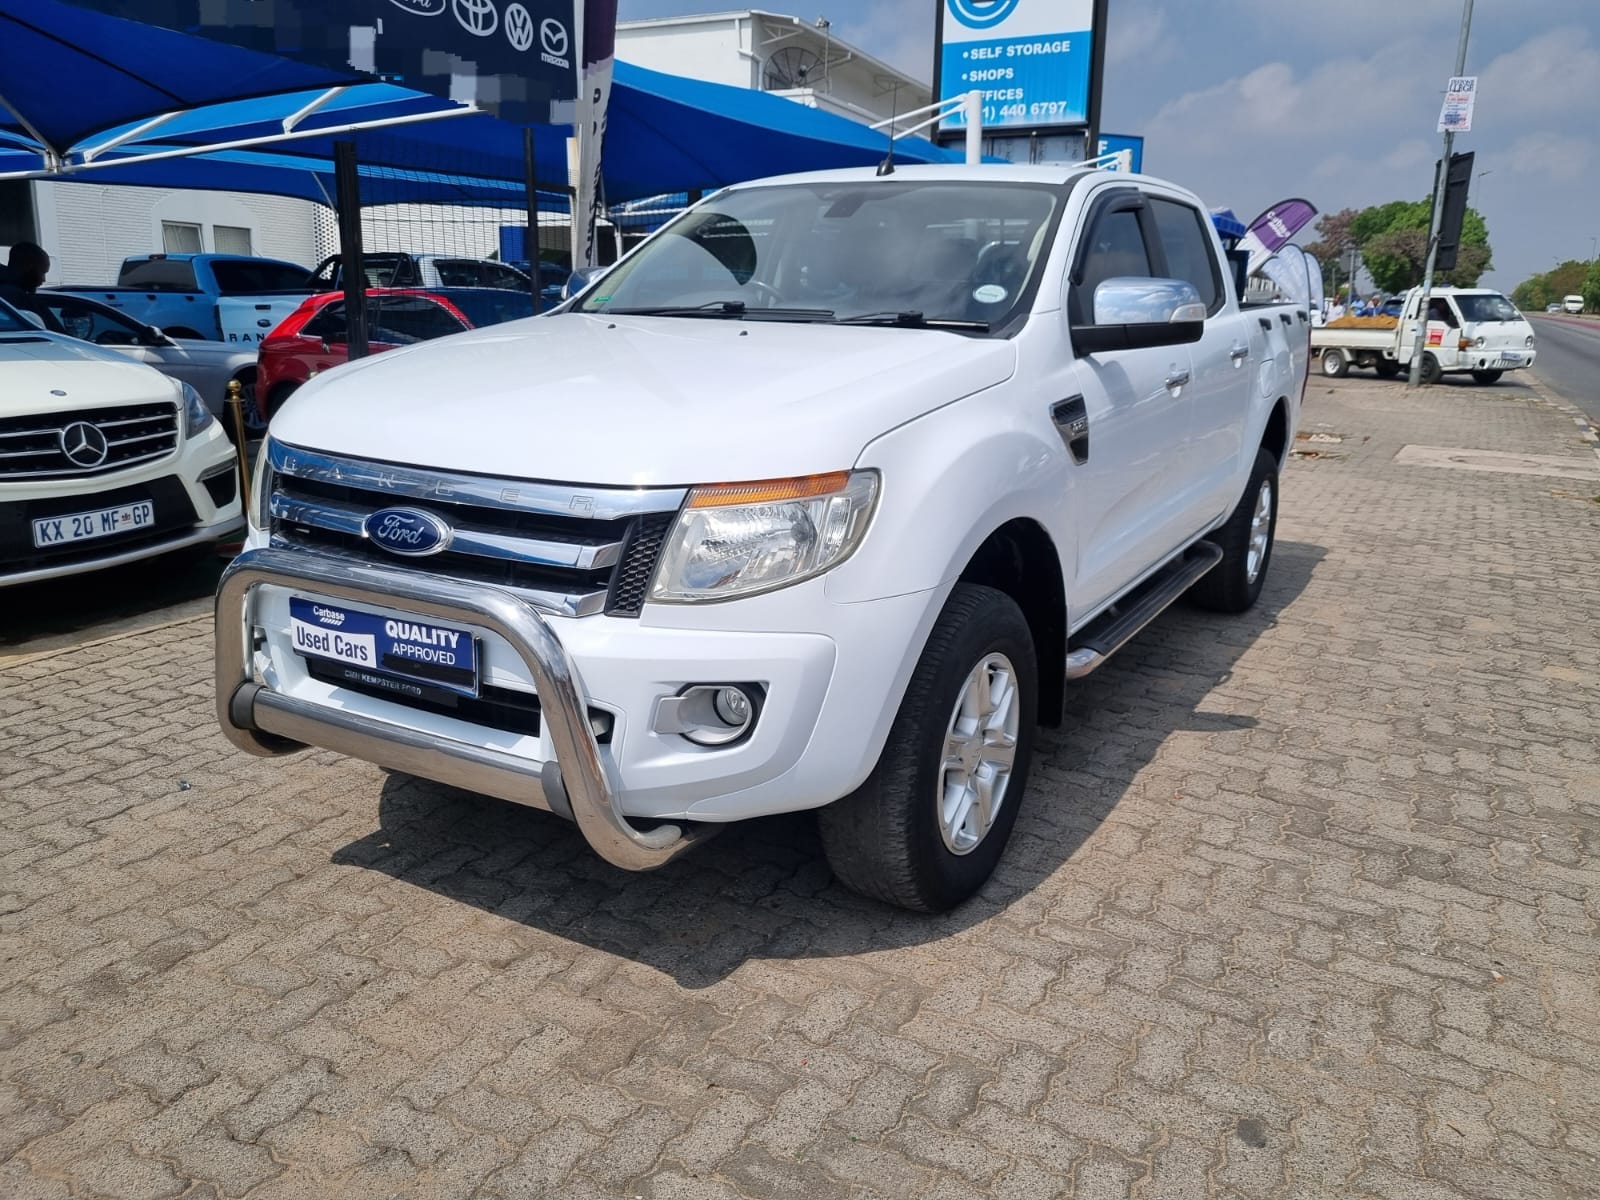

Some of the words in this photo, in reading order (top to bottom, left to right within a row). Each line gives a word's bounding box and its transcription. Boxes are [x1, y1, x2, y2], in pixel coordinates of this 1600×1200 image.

[970, 47, 1003, 60] SELF
[1006, 41, 1071, 57] STORAGE
[969, 68, 1014, 82] SHOPS
[981, 87, 1024, 102] FICES
[999, 104, 1027, 117] 440
[1030, 101, 1067, 116] 6797
[40, 519, 65, 543] KX
[72, 515, 94, 538] 20
[101, 510, 120, 533] MF
[132, 504, 151, 525] GP
[377, 514, 426, 545] Ford
[313, 605, 345, 621] Carbase
[296, 626, 331, 652] Used
[334, 634, 369, 662] Cars
[385, 621, 460, 648] QUALITY
[392, 642, 456, 666] APPROVED
